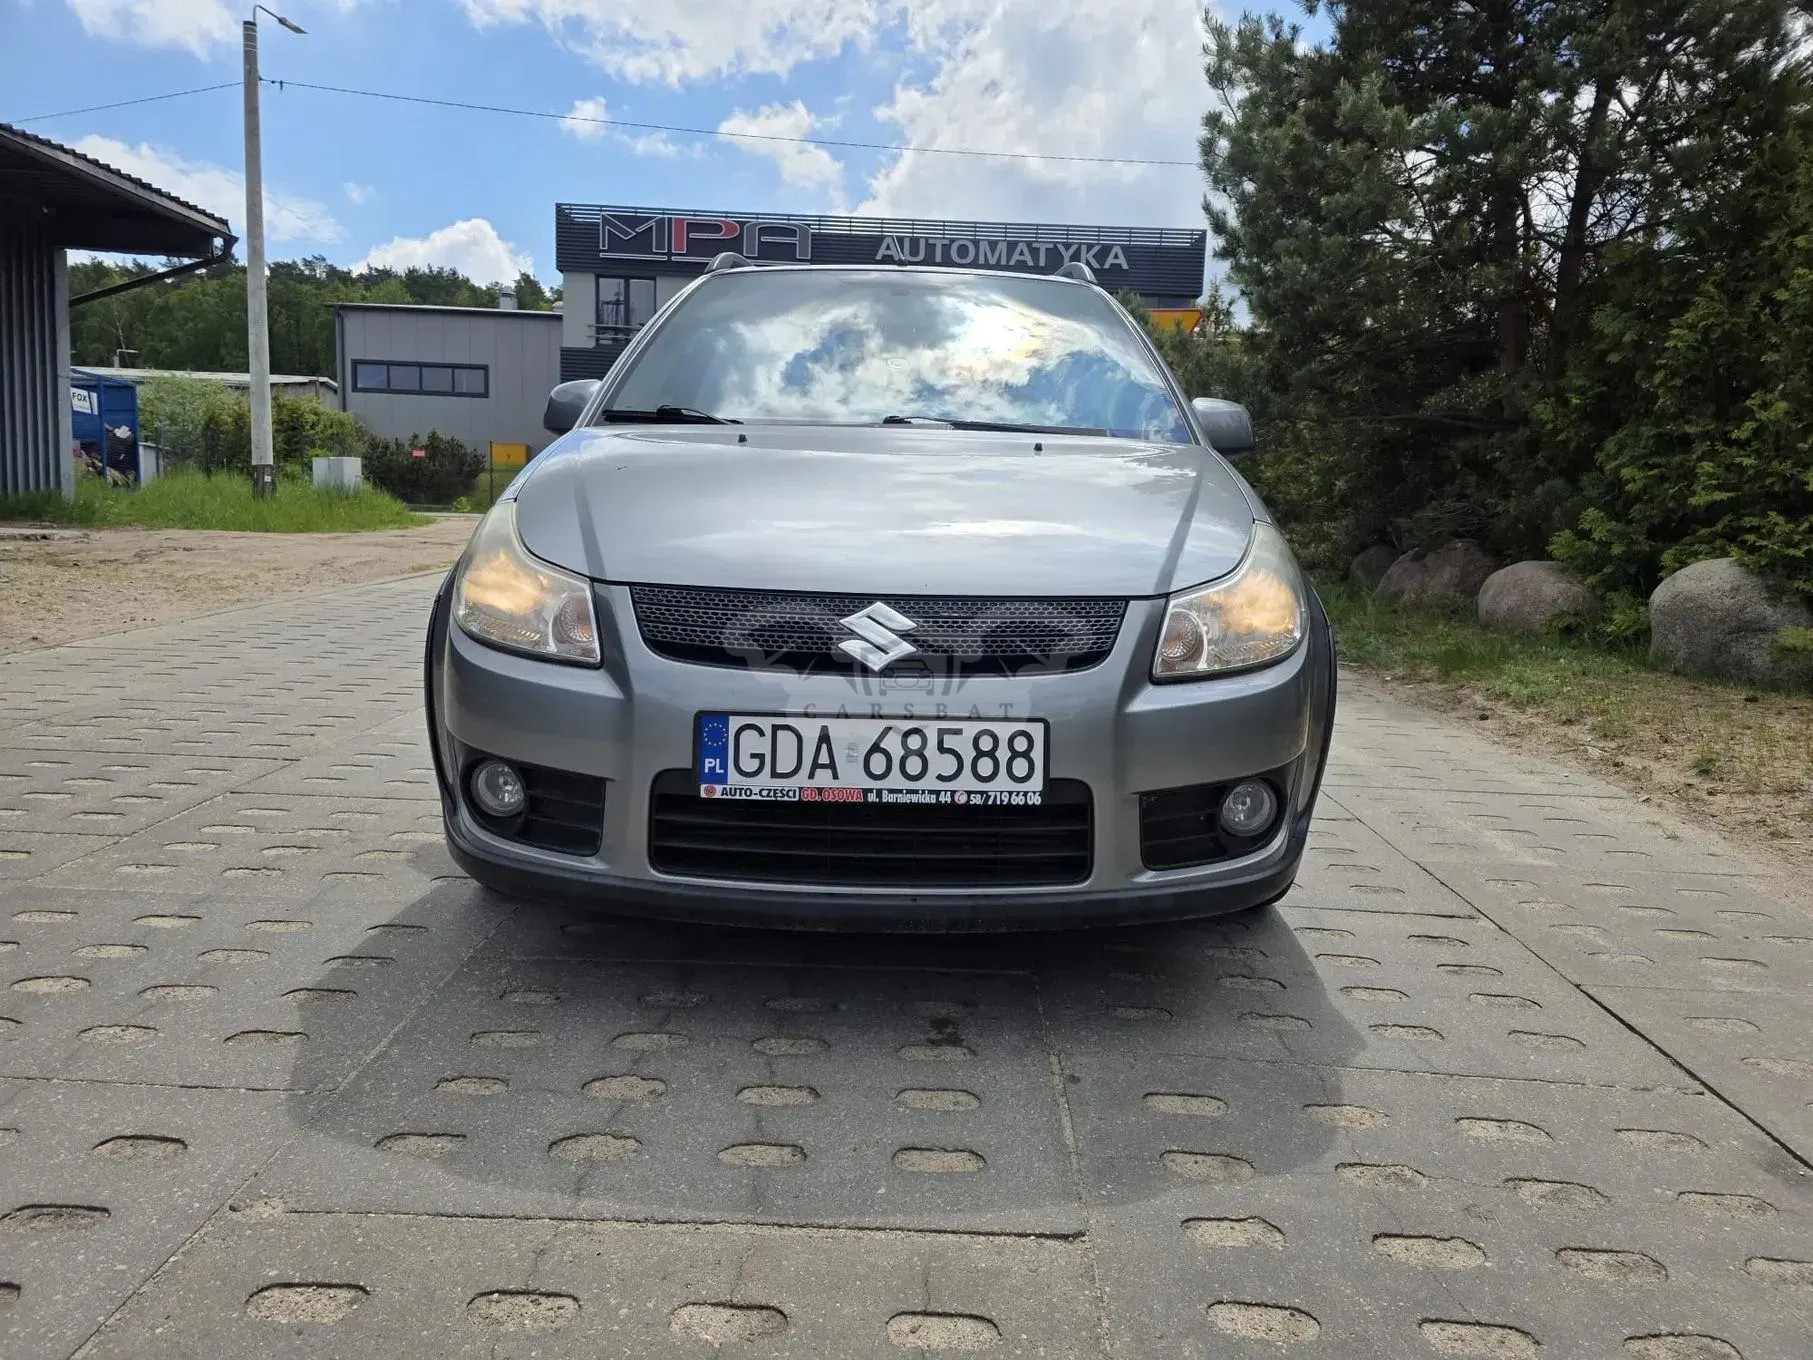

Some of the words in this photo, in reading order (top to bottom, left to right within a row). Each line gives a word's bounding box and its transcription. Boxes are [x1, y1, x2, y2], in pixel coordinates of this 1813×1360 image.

[600, 213, 811, 259] MPA
[875, 235, 1129, 270] AUTOMATYKA
[704, 759, 724, 773] PL
[733, 723, 840, 781] GDA
[863, 726, 1035, 784] 68588
[721, 786, 797, 800] AUTO-CZĘŚCI
[938, 791, 952, 804] 44
[969, 792, 986, 806] 58/
[987, 792, 1009, 805] 719
[1010, 792, 1025, 805] 66
[1026, 793, 1042, 806] 06
